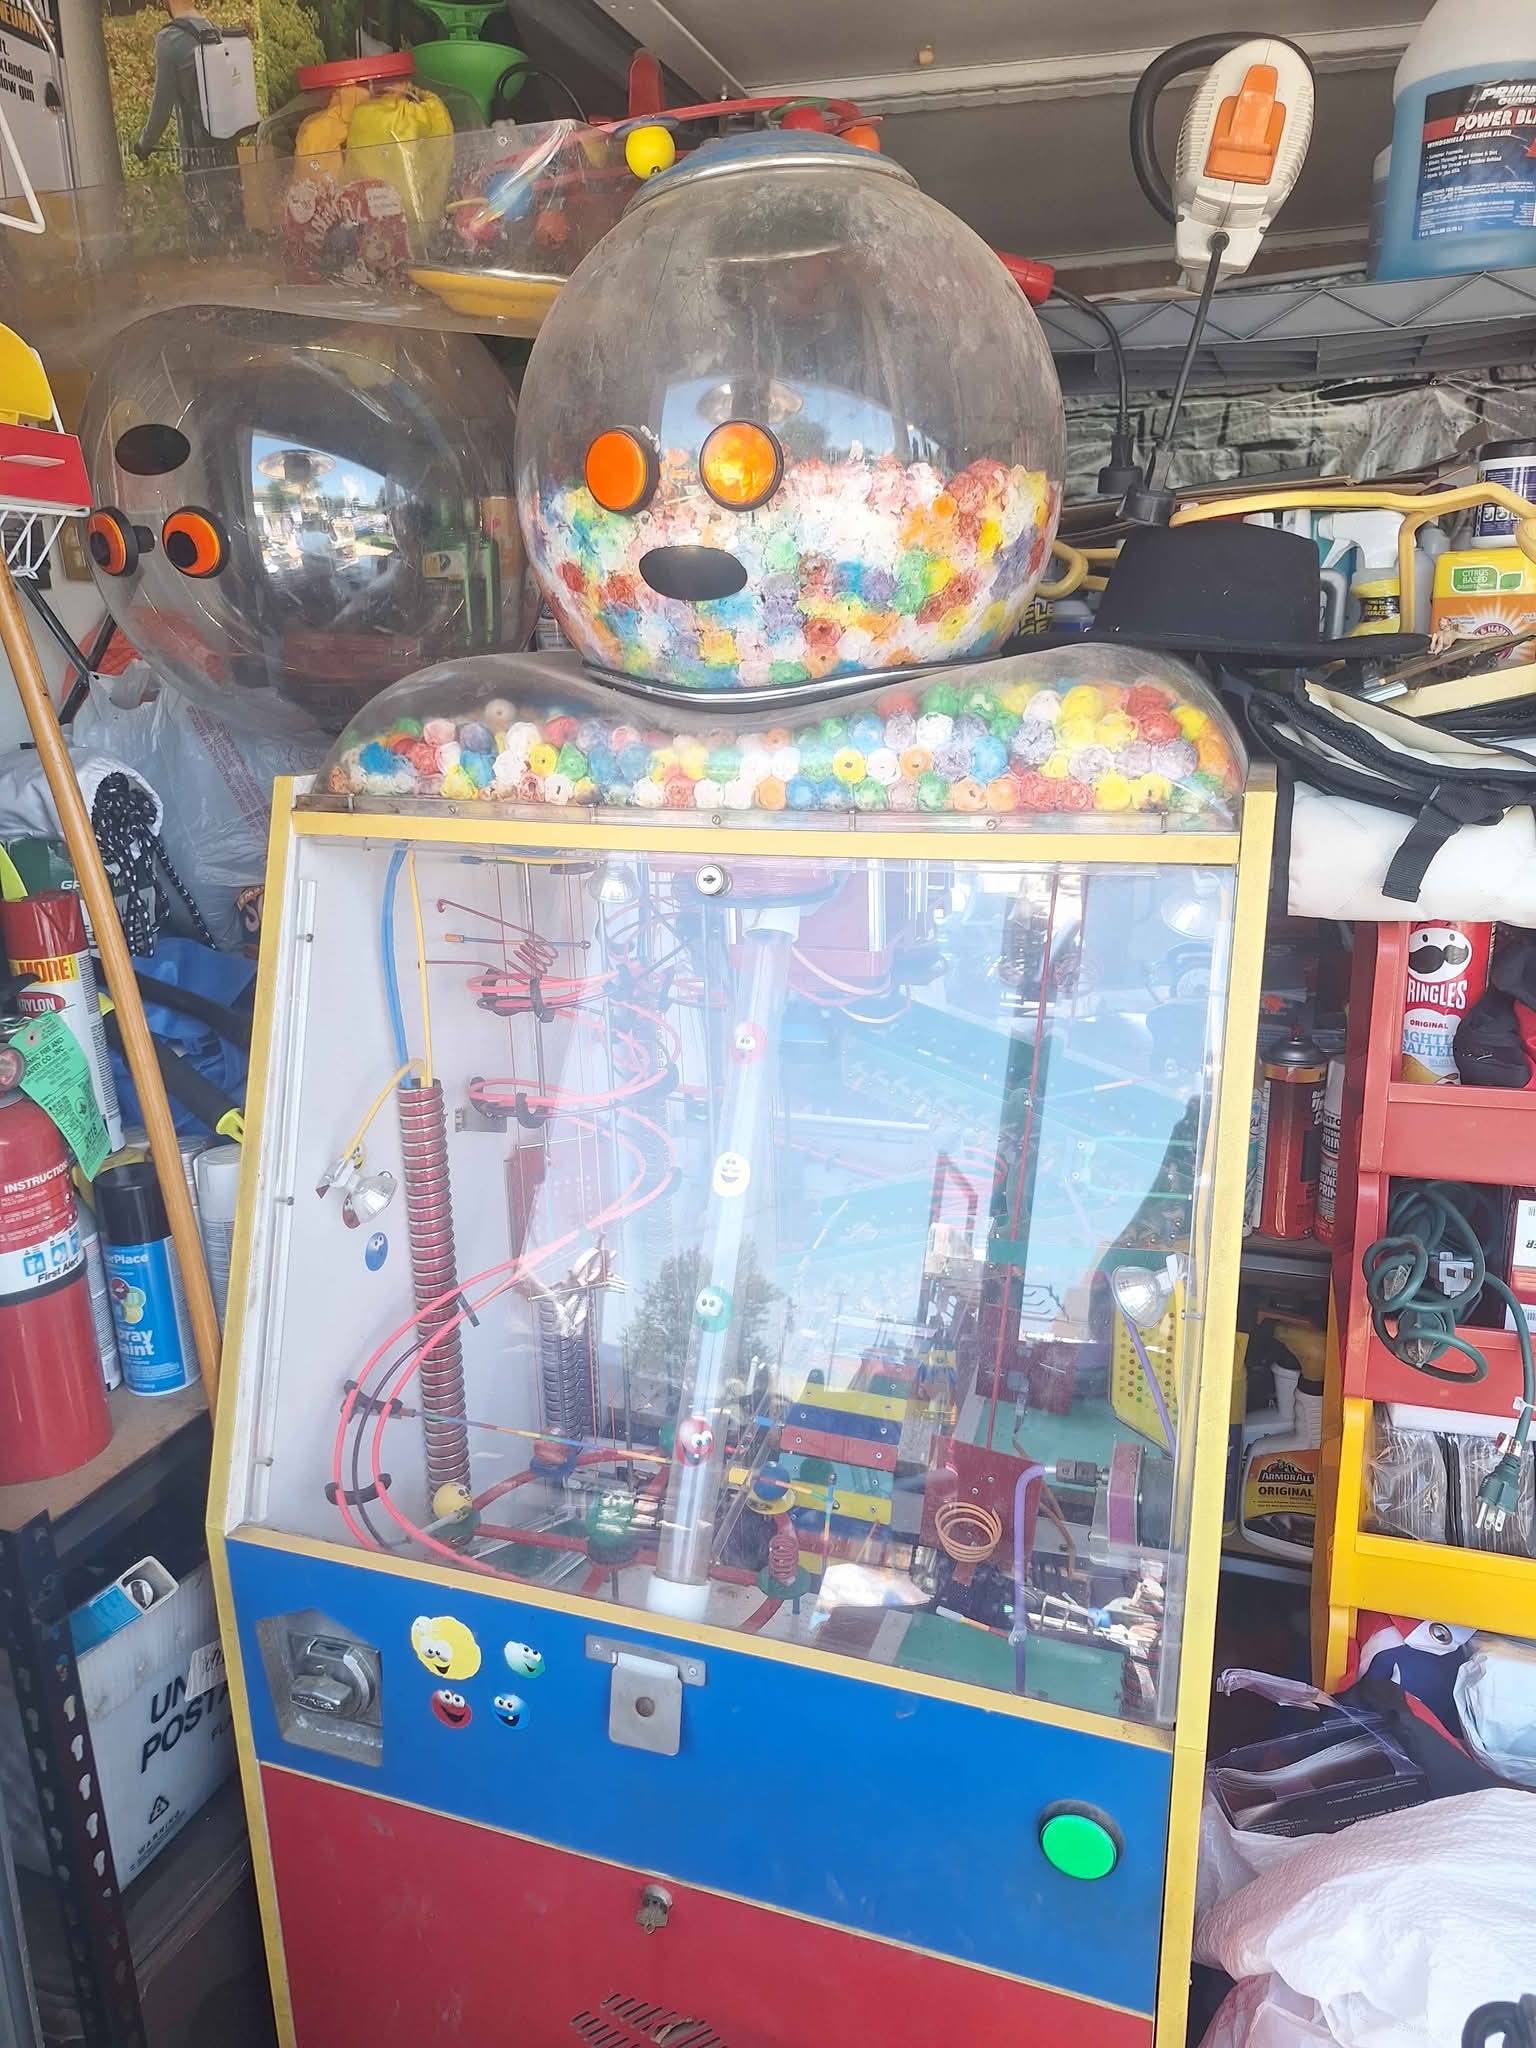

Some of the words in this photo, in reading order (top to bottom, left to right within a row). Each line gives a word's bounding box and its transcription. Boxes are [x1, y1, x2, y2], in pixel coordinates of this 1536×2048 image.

[1498, 97, 1536, 105] GUARD
[1454, 110, 1513, 132] POWER
[1427, 136, 1464, 149] WINDSHIELD
[1465, 131, 1492, 140] WASHER
[1493, 129, 1512, 137] FLUID
[1462, 568, 1489, 577] CITRUS
[1462, 575, 1488, 585] BASED
[1407, 978, 1468, 1010] RINGLES
[1410, 1019, 1449, 1030] ORIGINAL
[1403, 1028, 1457, 1046] IGHTL
[38, 1269, 61, 1284] First
[1258, 1486, 1314, 1497] ORIGINAL
